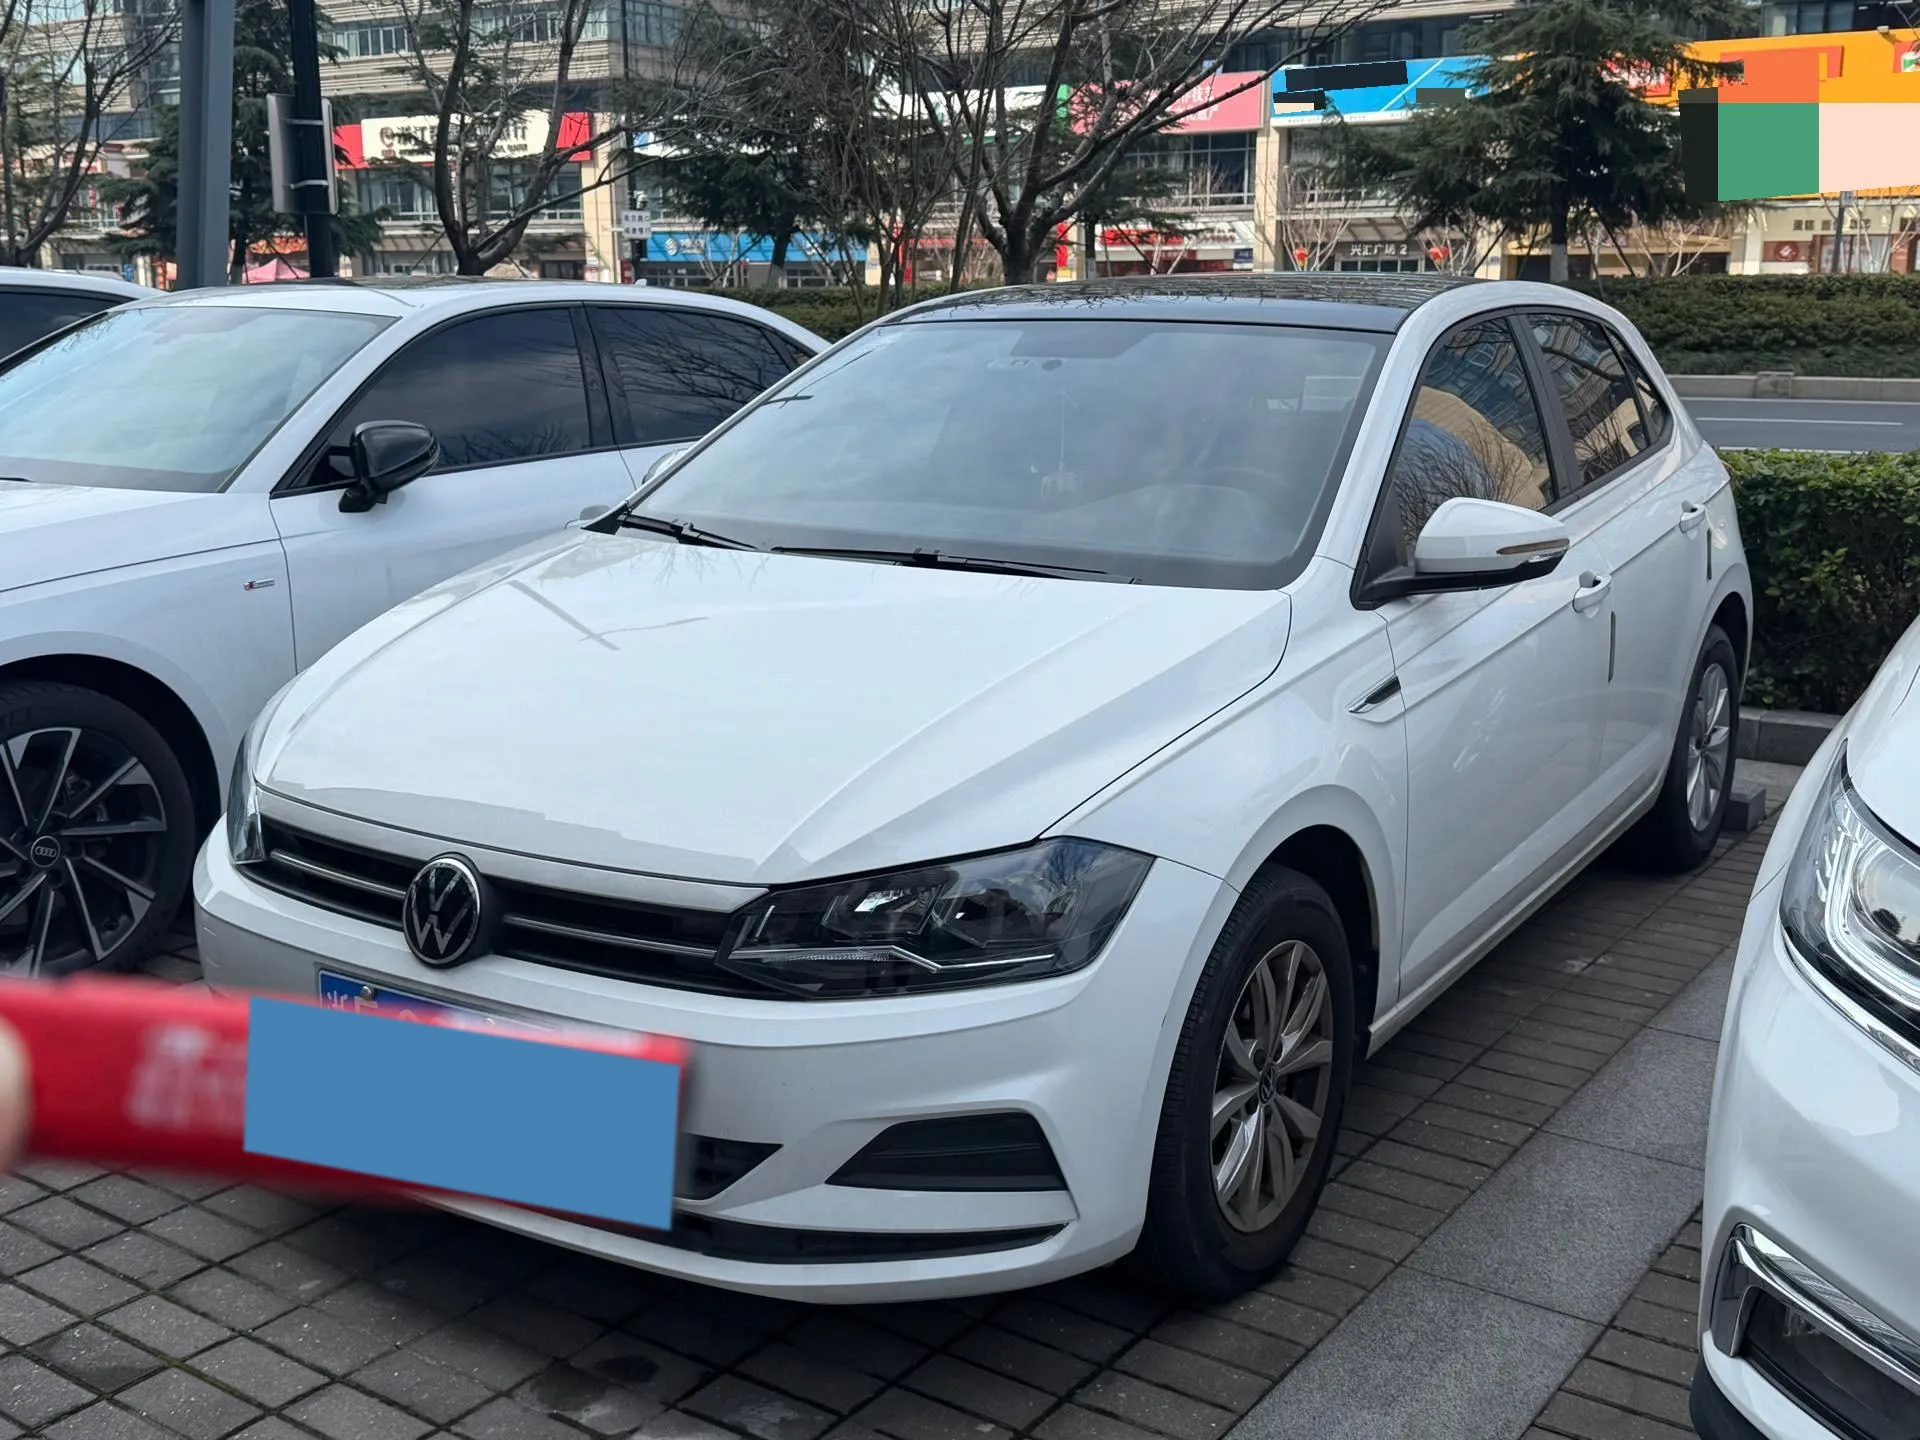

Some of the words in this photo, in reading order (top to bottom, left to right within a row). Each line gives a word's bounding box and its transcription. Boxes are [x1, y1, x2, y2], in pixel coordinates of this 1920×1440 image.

[1349, 243, 1396, 256] 兴汇广场
[1399, 243, 1408, 255] 2
